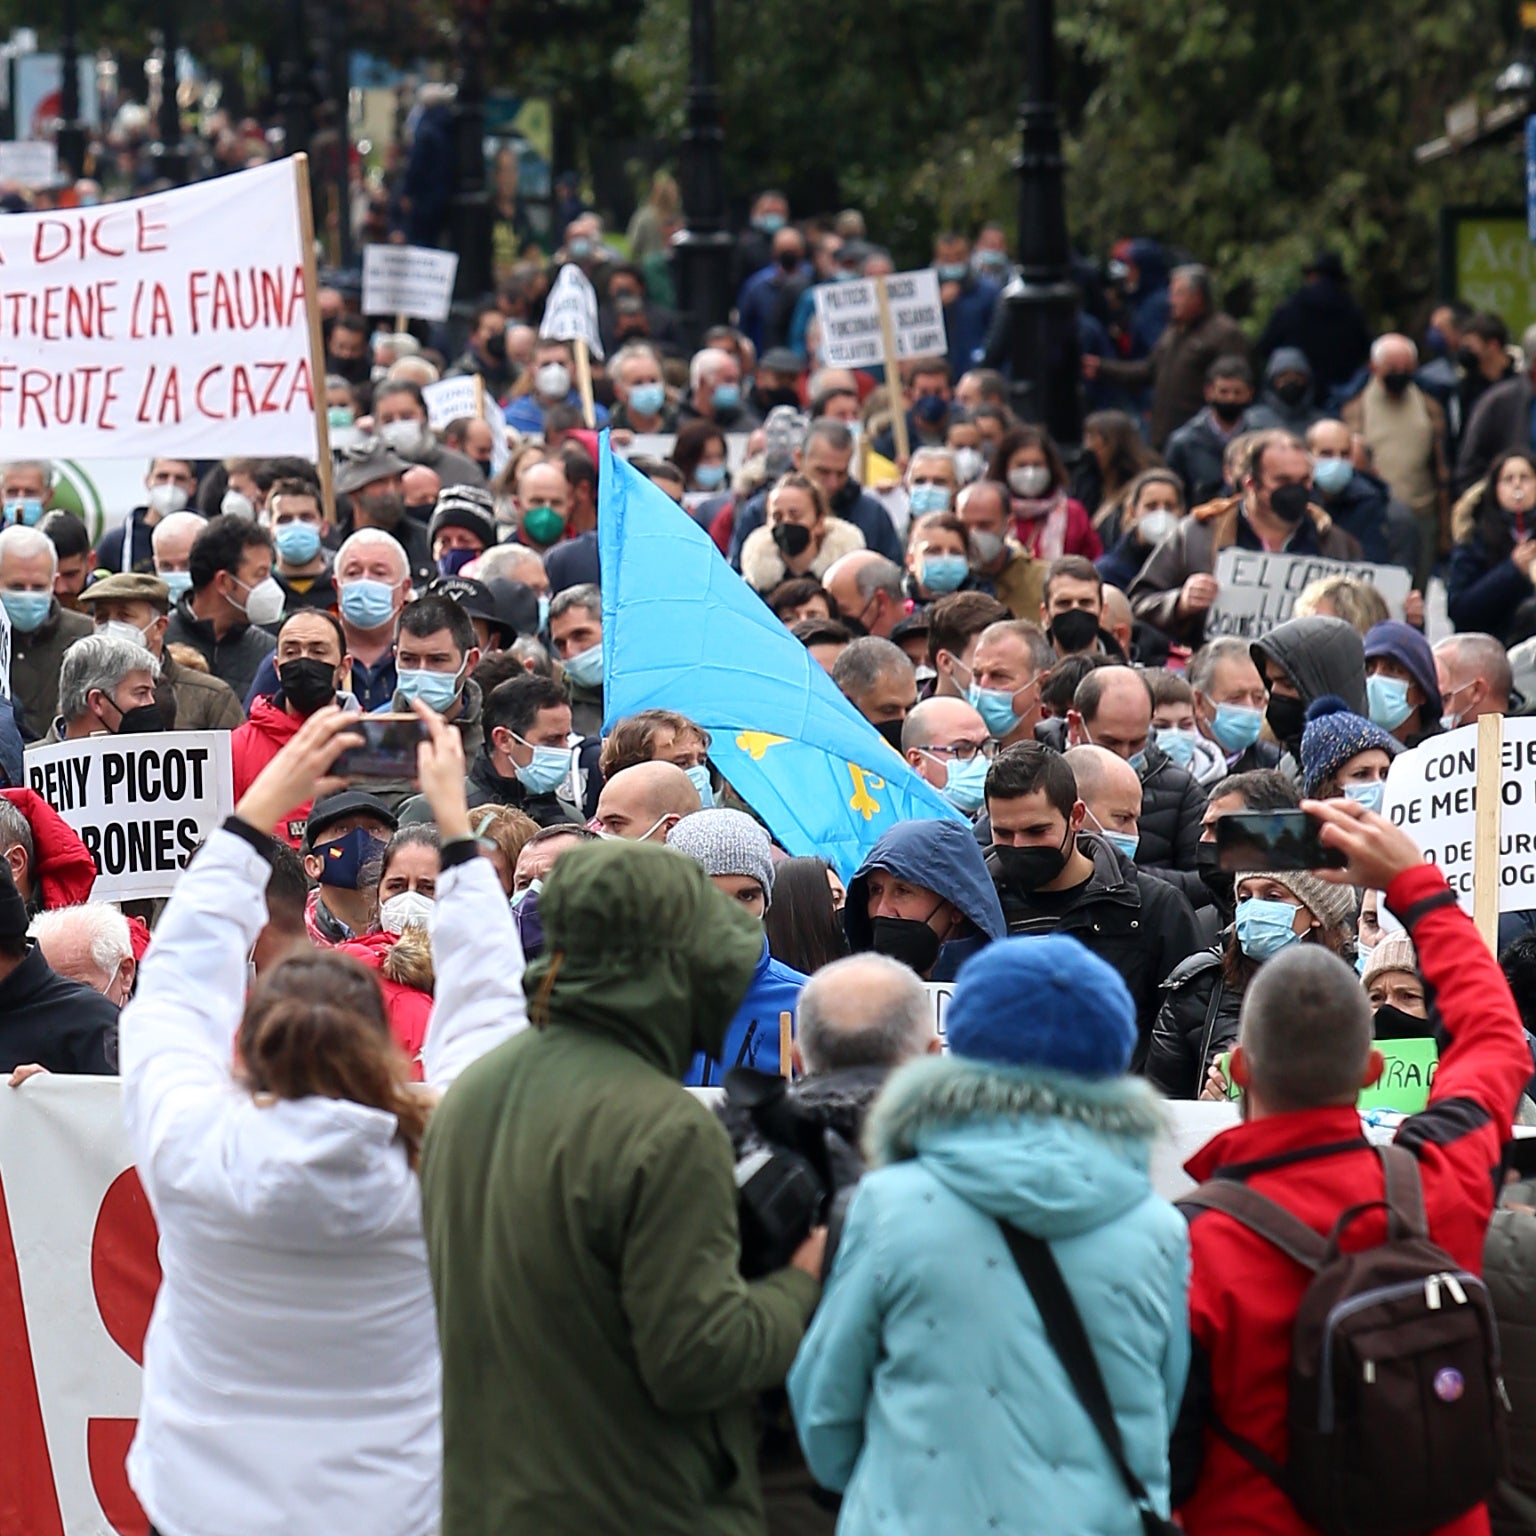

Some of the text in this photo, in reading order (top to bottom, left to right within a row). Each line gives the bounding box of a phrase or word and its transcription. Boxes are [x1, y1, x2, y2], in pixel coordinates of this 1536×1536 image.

[33, 203, 168, 264] DICE
[130, 279, 173, 339] LA
[189, 264, 308, 335] FAUNA
[136, 363, 181, 424] LA
[195, 357, 316, 419] CAZA
[1231, 555, 1272, 588] EL
[102, 748, 209, 805] PICOT
[1425, 740, 1536, 783] CONEJE
[1390, 780, 1522, 827] DE MEO
[1444, 840, 1473, 865] DE
